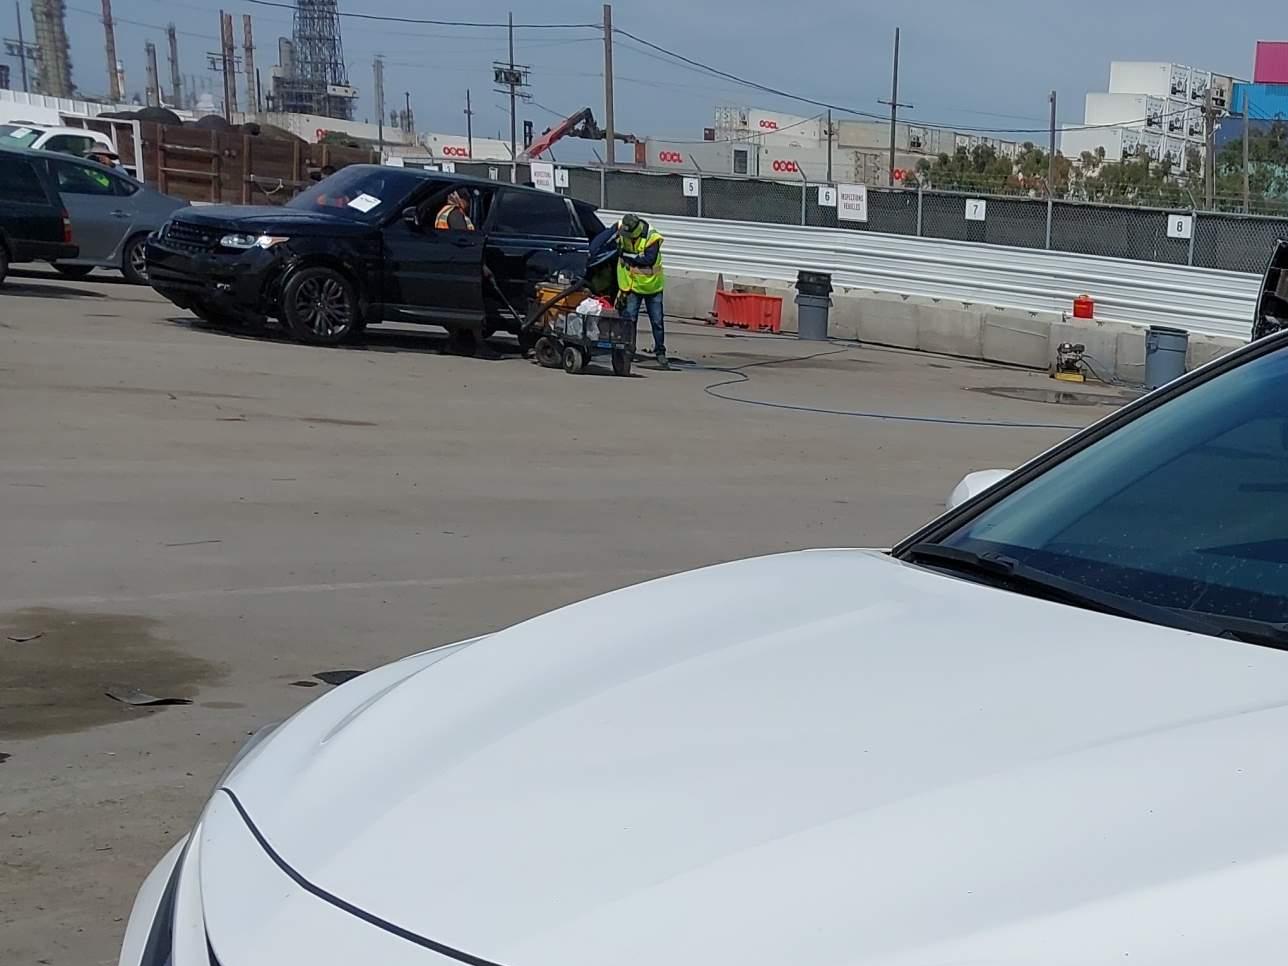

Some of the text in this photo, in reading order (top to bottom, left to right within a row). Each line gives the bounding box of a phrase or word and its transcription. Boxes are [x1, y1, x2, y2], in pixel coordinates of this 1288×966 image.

[759, 119, 779, 130] OOCL
[442, 146, 469, 157] OOCL
[659, 151, 683, 163] OOCL
[772, 160, 798, 172] OOCL
[559, 173, 565, 183] 4
[689, 182, 694, 192] 5
[825, 191, 830, 201] 6
[973, 205, 979, 215] 7
[1176, 220, 1184, 233] 8
